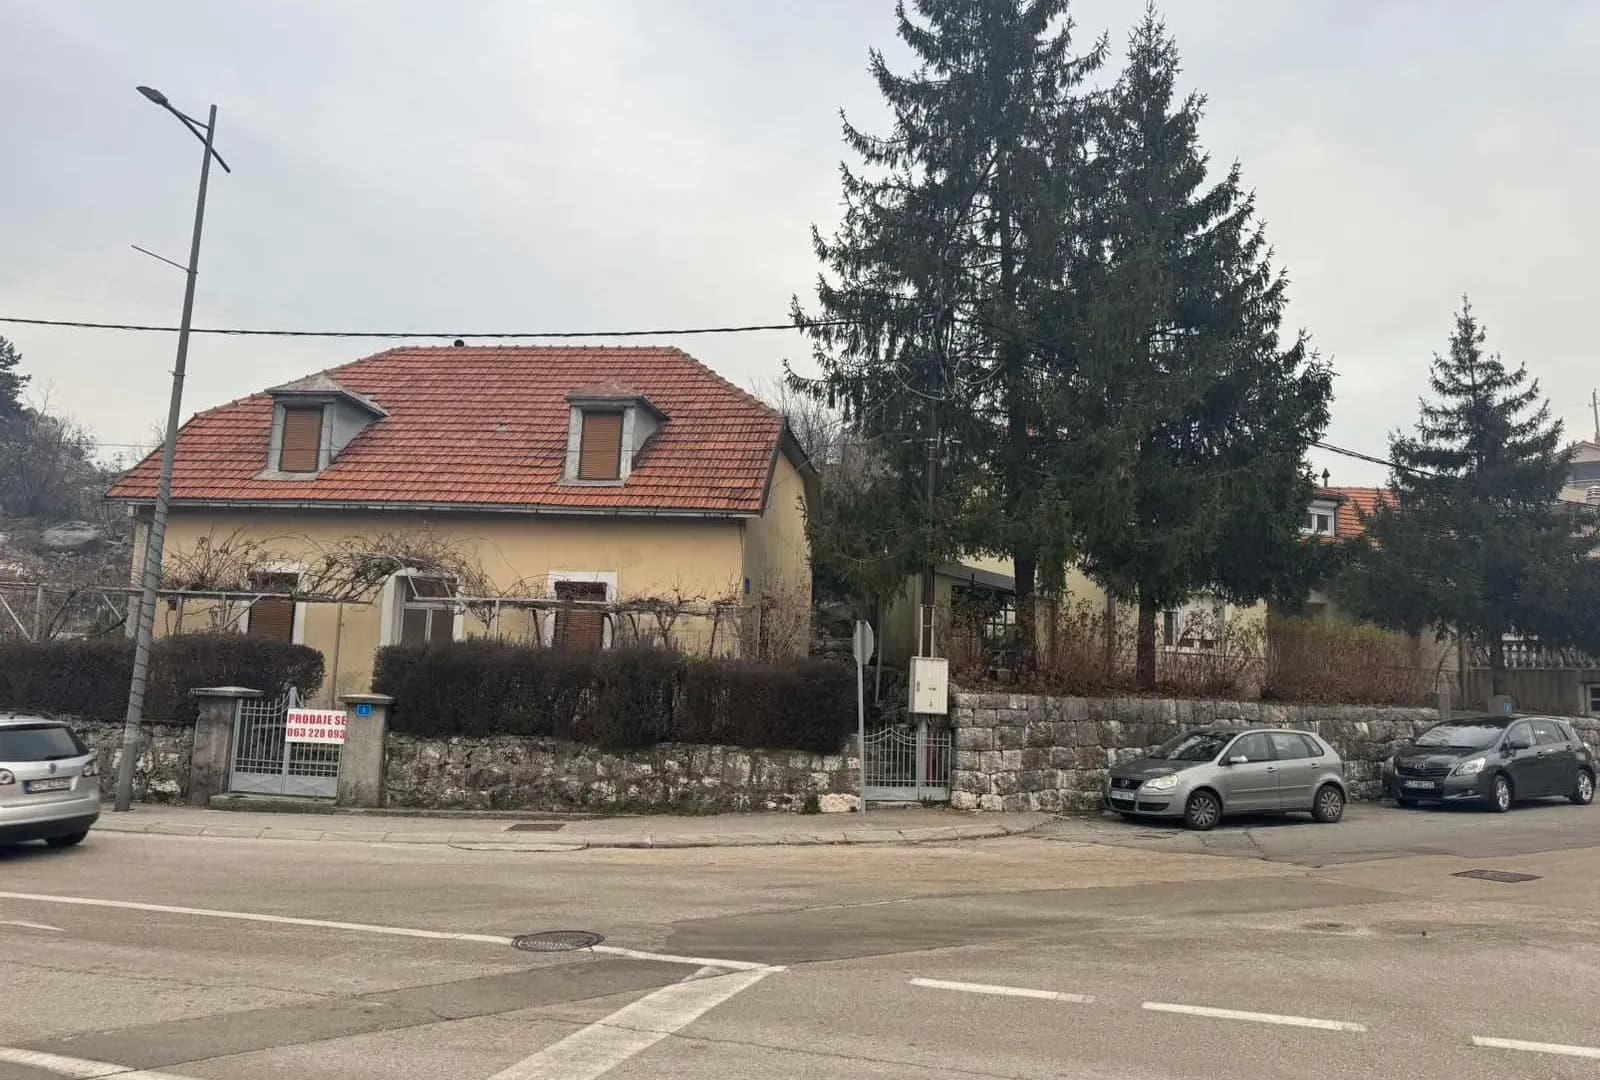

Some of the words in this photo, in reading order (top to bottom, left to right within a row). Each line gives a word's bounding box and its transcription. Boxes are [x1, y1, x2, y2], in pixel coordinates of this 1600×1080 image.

[288, 713, 332, 725] PRODAJE
[334, 715, 348, 725] SE
[287, 727, 306, 737] 063
